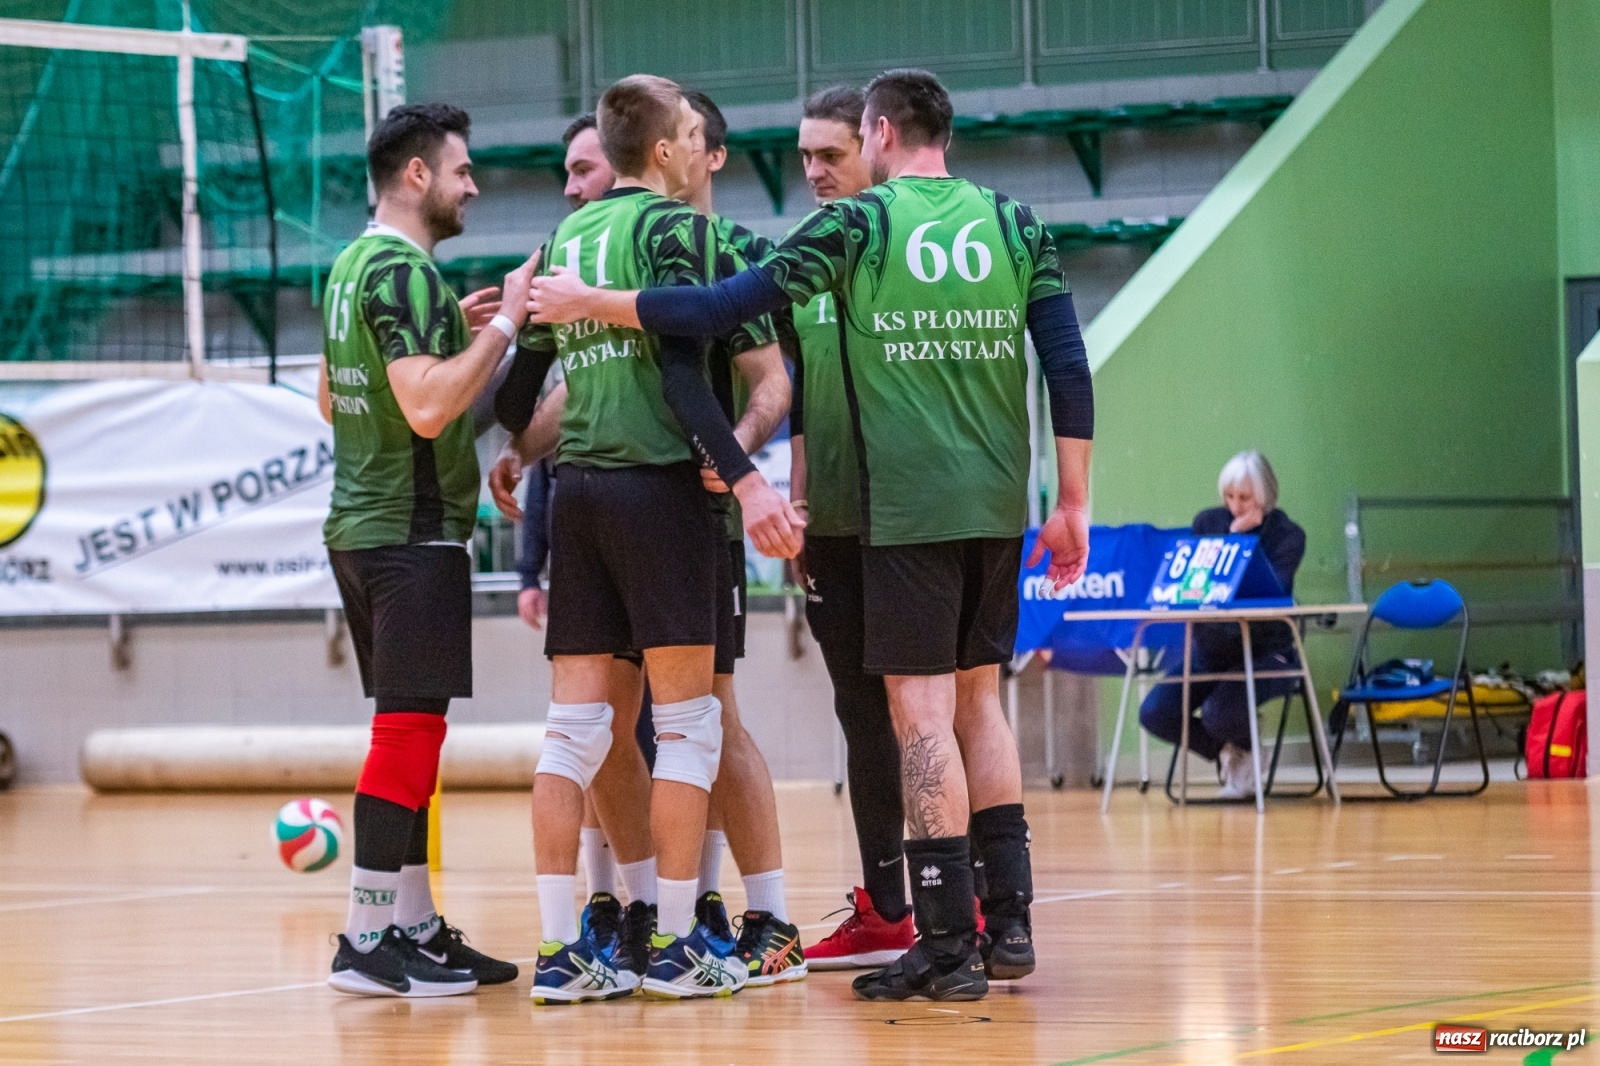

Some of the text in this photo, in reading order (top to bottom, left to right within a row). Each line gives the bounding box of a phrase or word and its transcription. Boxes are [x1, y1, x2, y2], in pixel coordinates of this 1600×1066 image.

[559, 226, 613, 287] 11
[905, 218, 992, 283] 66
[329, 281, 355, 342] 15
[816, 295, 838, 324] 1
[872, 303, 1020, 332] KS PŁOMIEŃ
[883, 334, 1016, 363] PRZYSTAJŃ
[74, 506, 158, 574] JEST
[166, 489, 203, 534] W
